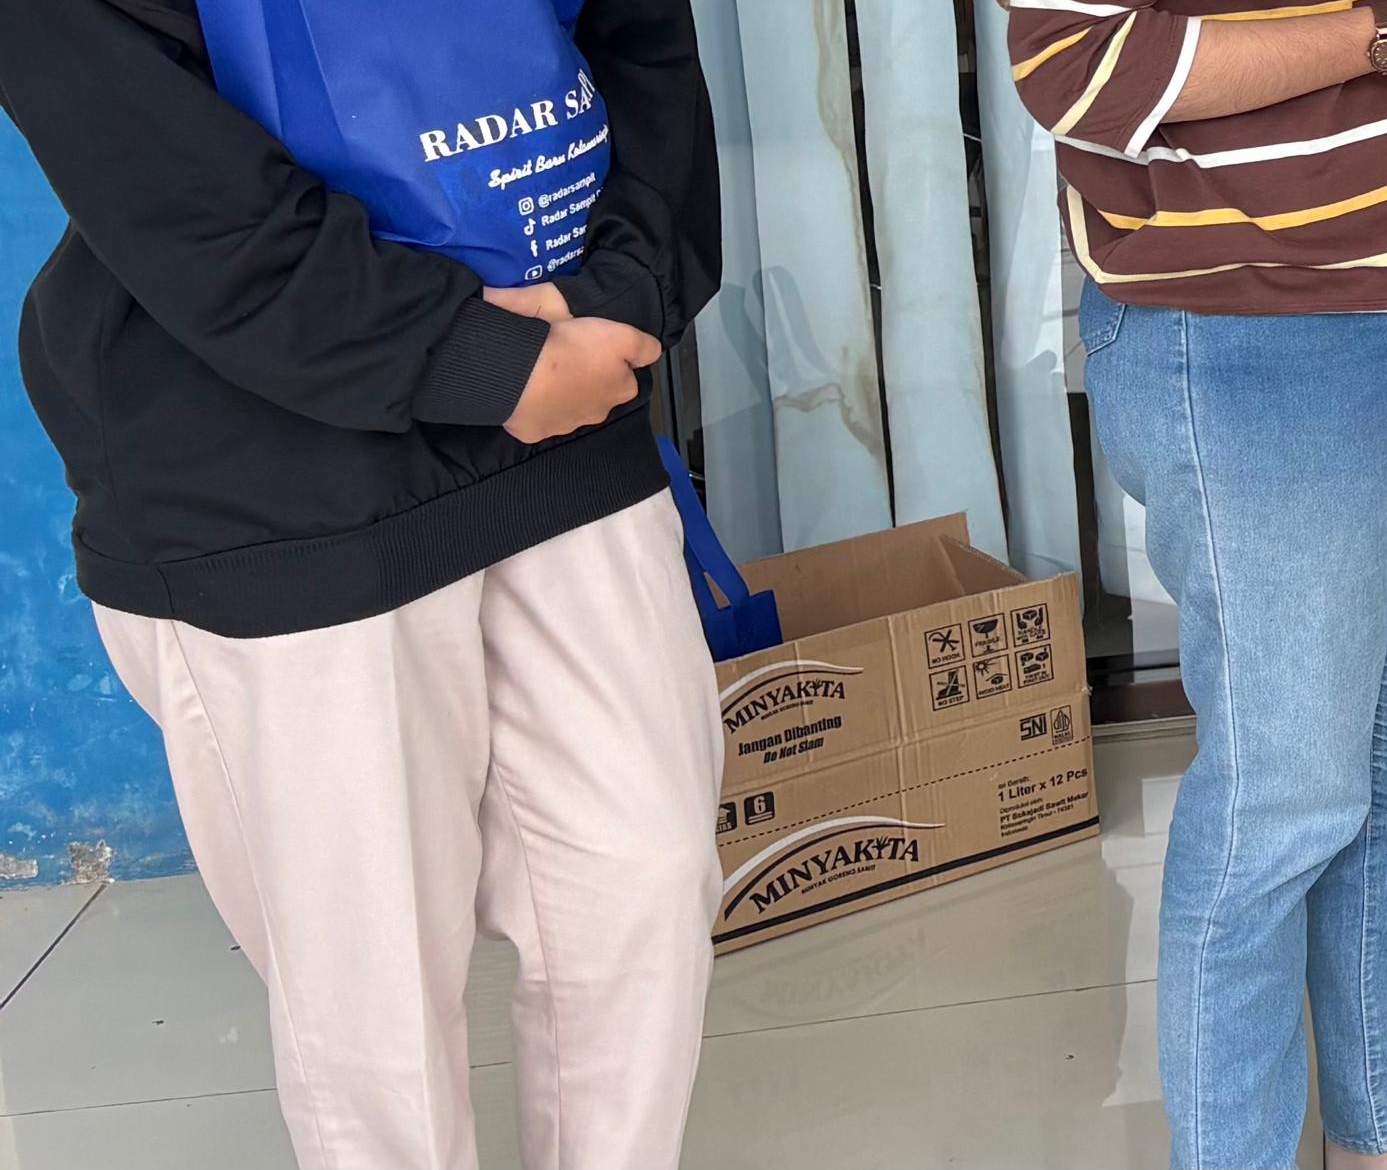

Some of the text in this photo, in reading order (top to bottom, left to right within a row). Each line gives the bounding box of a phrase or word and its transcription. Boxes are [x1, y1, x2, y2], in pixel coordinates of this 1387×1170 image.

[419, 99, 559, 162] RADAR
[488, 159, 532, 191] Spirit
[535, 152, 566, 174] Baru
[538, 171, 596, 208] @radarsampit
[541, 208, 568, 226] Radar
[545, 232, 572, 251] Radar
[738, 715, 842, 756] Jangan Dibanting
[1020, 713, 1047, 741] SNI
[763, 737, 824, 764] Do Not Slam
[998, 768, 1088, 802] 1 Liter x 12 Pcs
[753, 796, 767, 813] 6
[1001, 815, 1010, 823] PT
